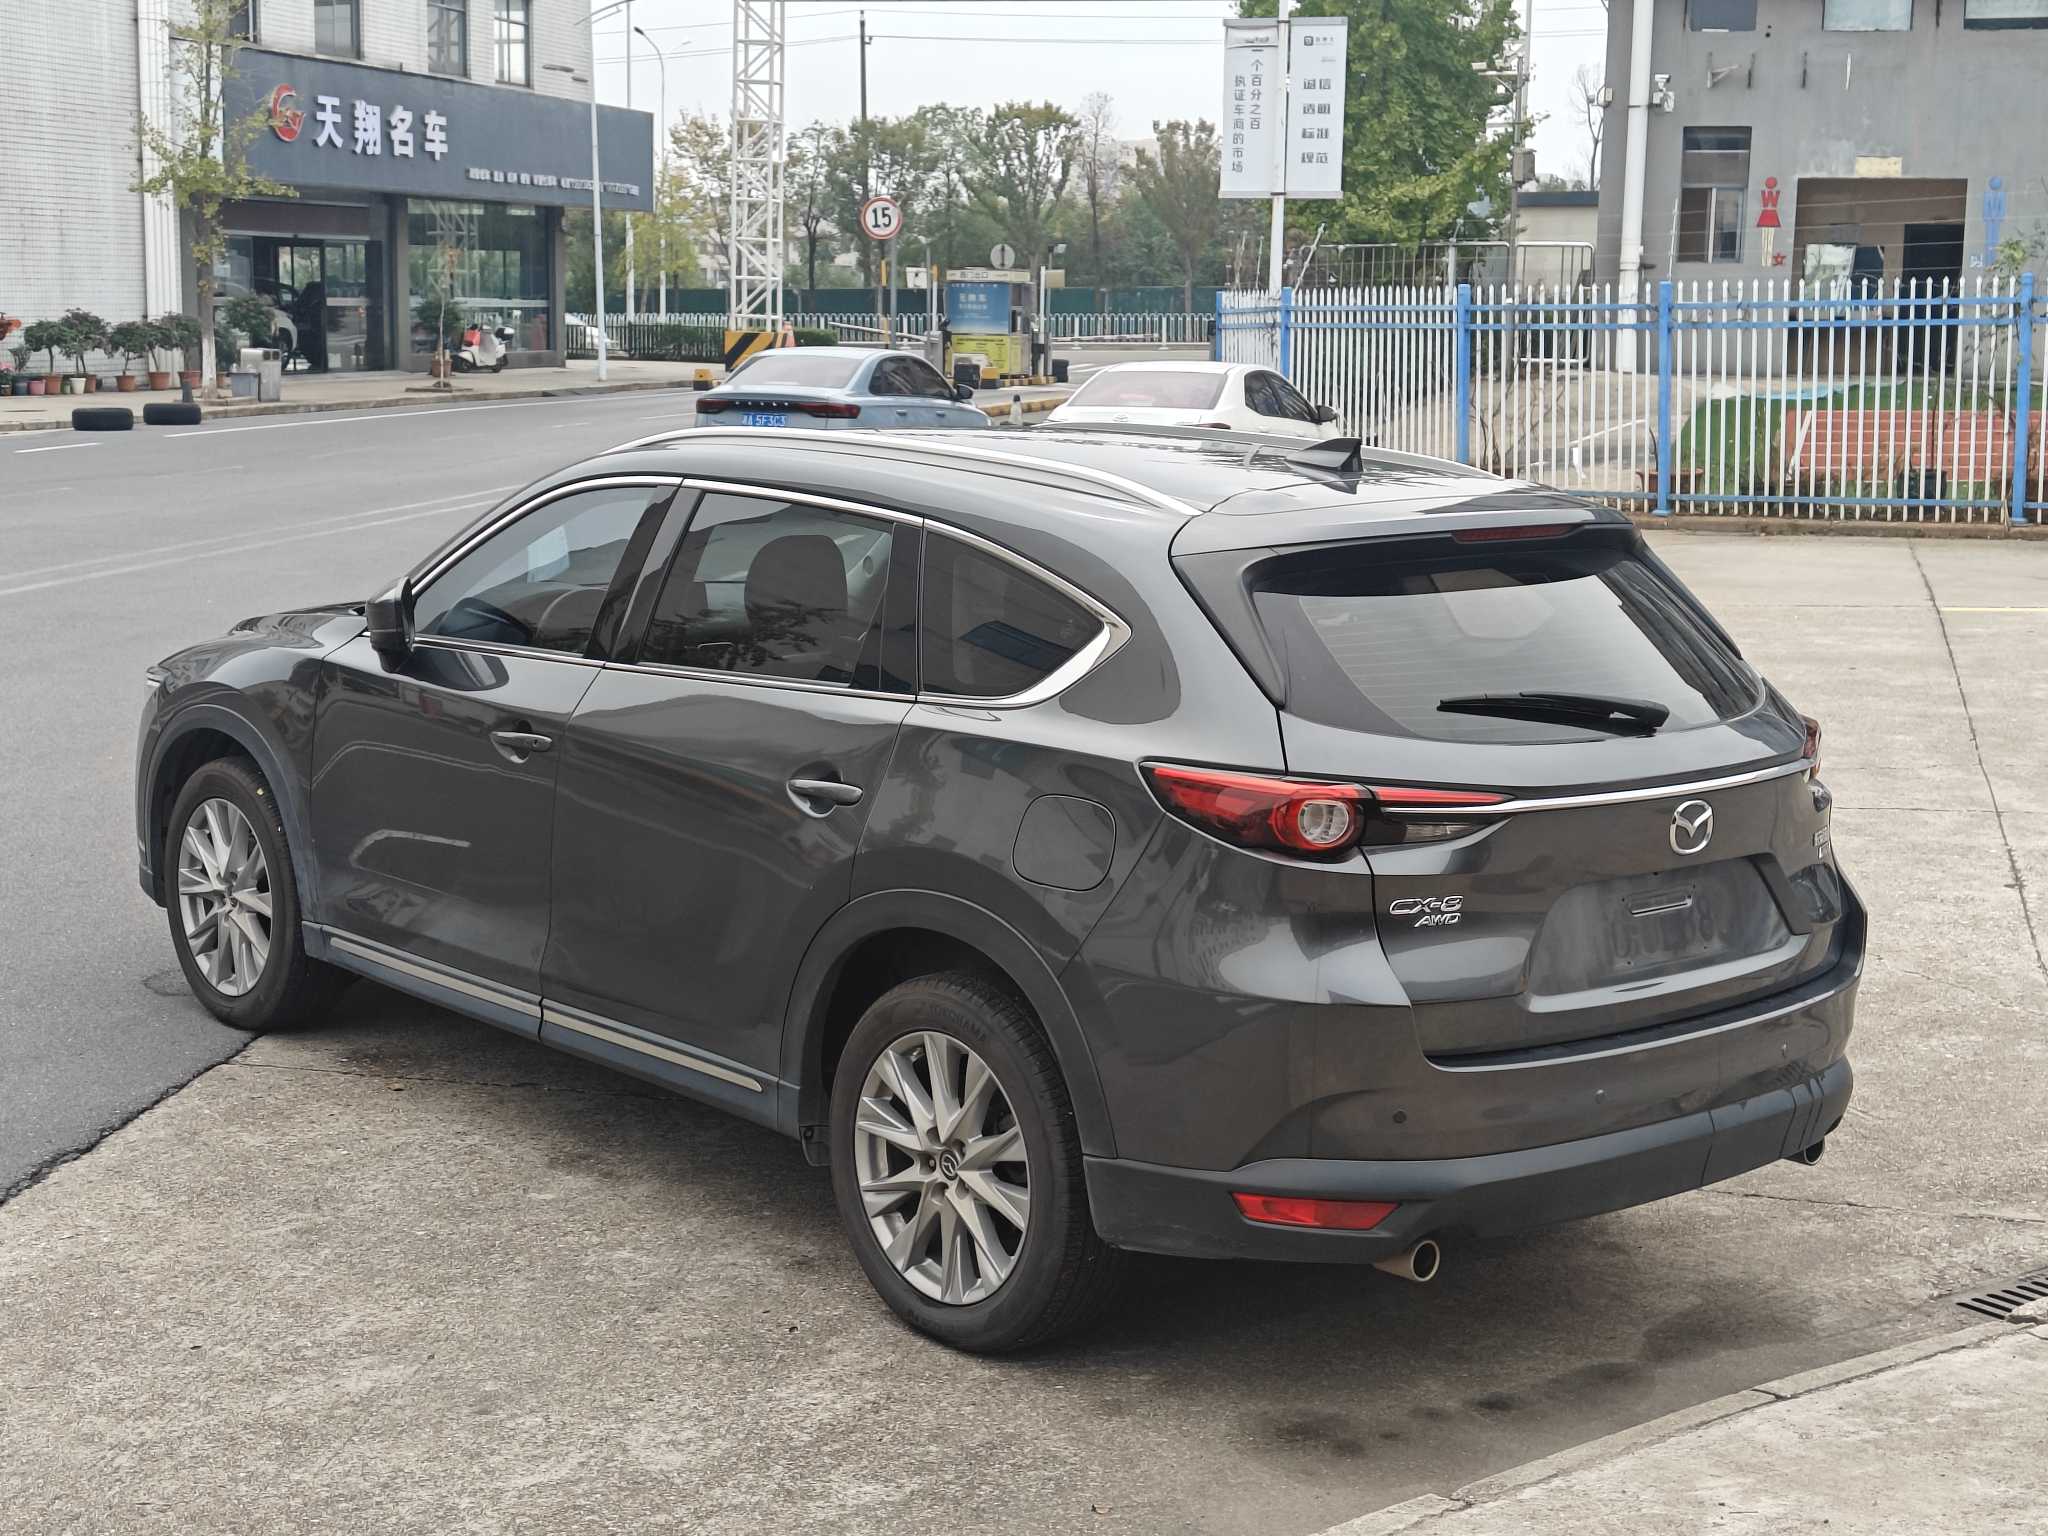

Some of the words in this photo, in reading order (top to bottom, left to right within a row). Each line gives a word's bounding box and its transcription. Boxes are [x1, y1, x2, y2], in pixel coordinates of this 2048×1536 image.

[316, 95, 449, 161] 天翔名车
[872, 207, 892, 228] 15
[1390, 895, 1464, 914] CX-8
[1414, 912, 1461, 928] AWD
